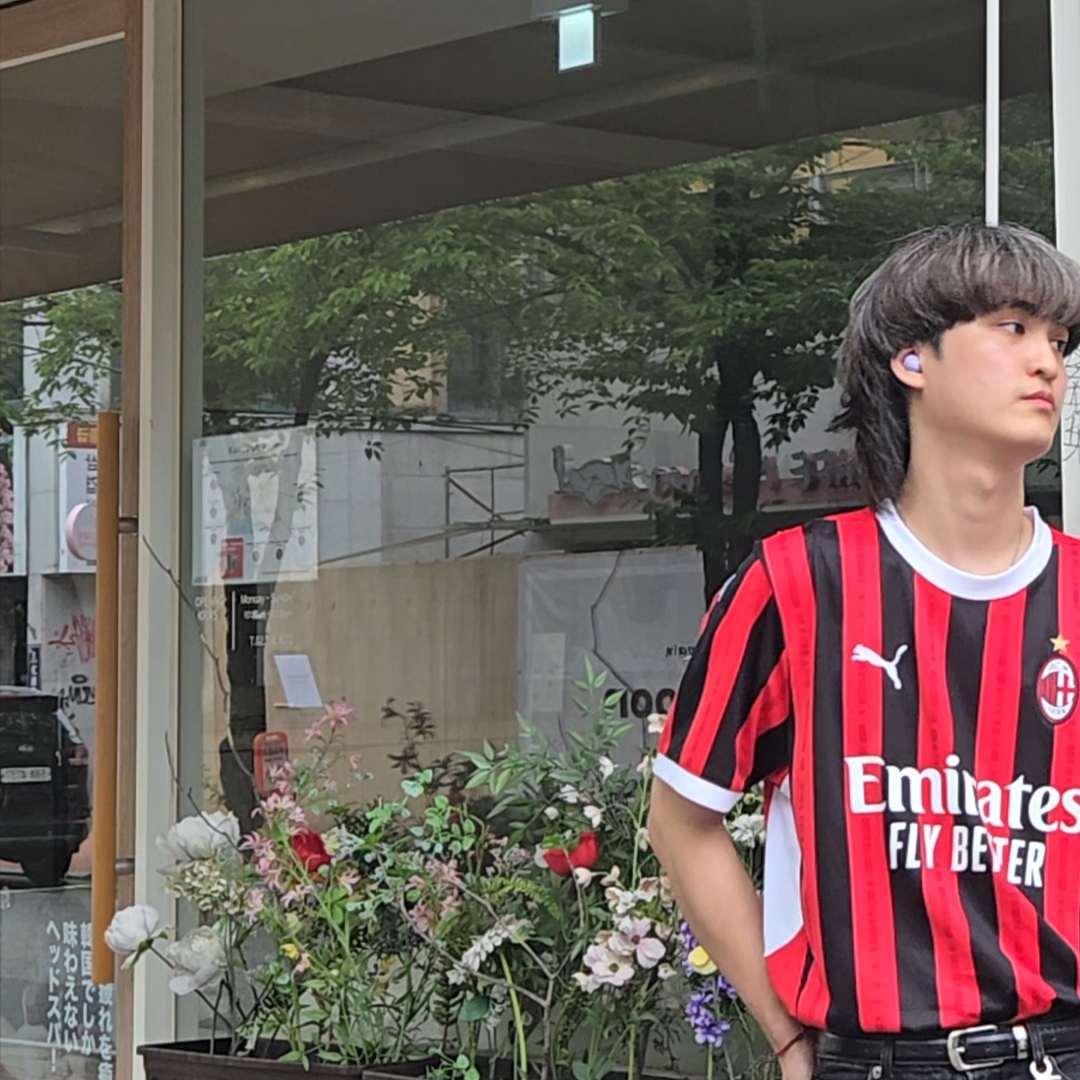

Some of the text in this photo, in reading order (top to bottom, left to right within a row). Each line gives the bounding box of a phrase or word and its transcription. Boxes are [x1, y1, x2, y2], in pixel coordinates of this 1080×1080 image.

[889, 822, 942, 870] FLY
[62, 921, 79, 1053] 味わえない
